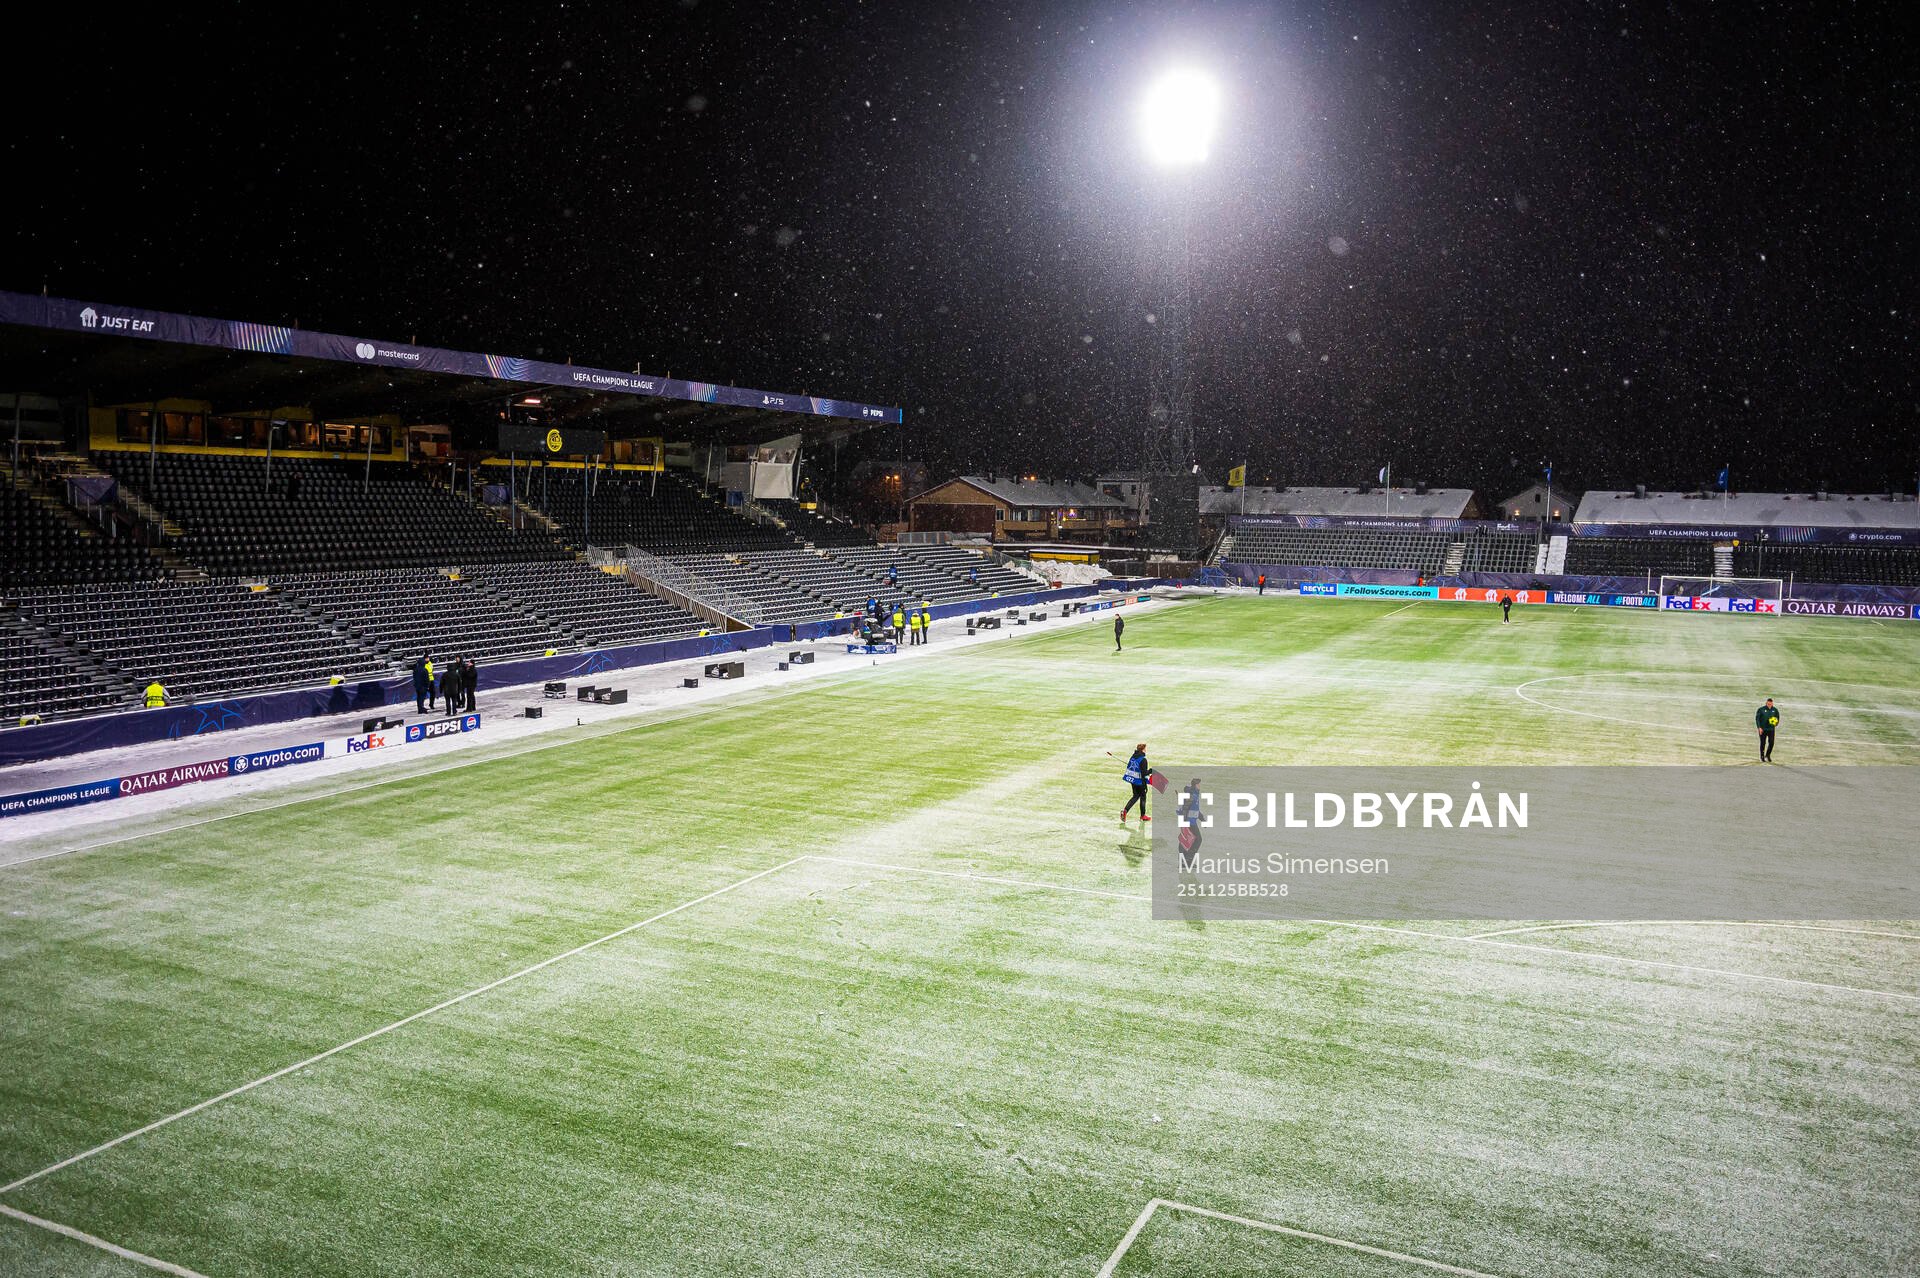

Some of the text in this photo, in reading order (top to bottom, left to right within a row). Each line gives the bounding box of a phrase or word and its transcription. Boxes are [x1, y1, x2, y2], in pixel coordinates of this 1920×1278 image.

[101, 315, 154, 332] JUST EAT
[377, 349, 419, 361] mastercard
[573, 372, 653, 390] UEFA CHAMPIONS LEAGUE
[769, 396, 784, 406] PS5
[1859, 533, 1902, 541] crypto.com
[1303, 585, 1335, 593] RECYCLE
[1553, 593, 1600, 605] WELCOME ALL
[1615, 596, 1656, 607] #FOOTBALL
[1666, 595, 1711, 611] FedEx
[1728, 598, 1775, 613] FedEx
[1787, 601, 1905, 617] QATAR AIRWAYS
[426, 719, 461, 737] PEPSI
[347, 733, 384, 753] FedEx
[252, 745, 320, 767] crypto.com
[120, 761, 229, 793] QATAR AIRWAYS
[1, 786, 110, 811] UEFA CHAMPIONS LEAGUE
